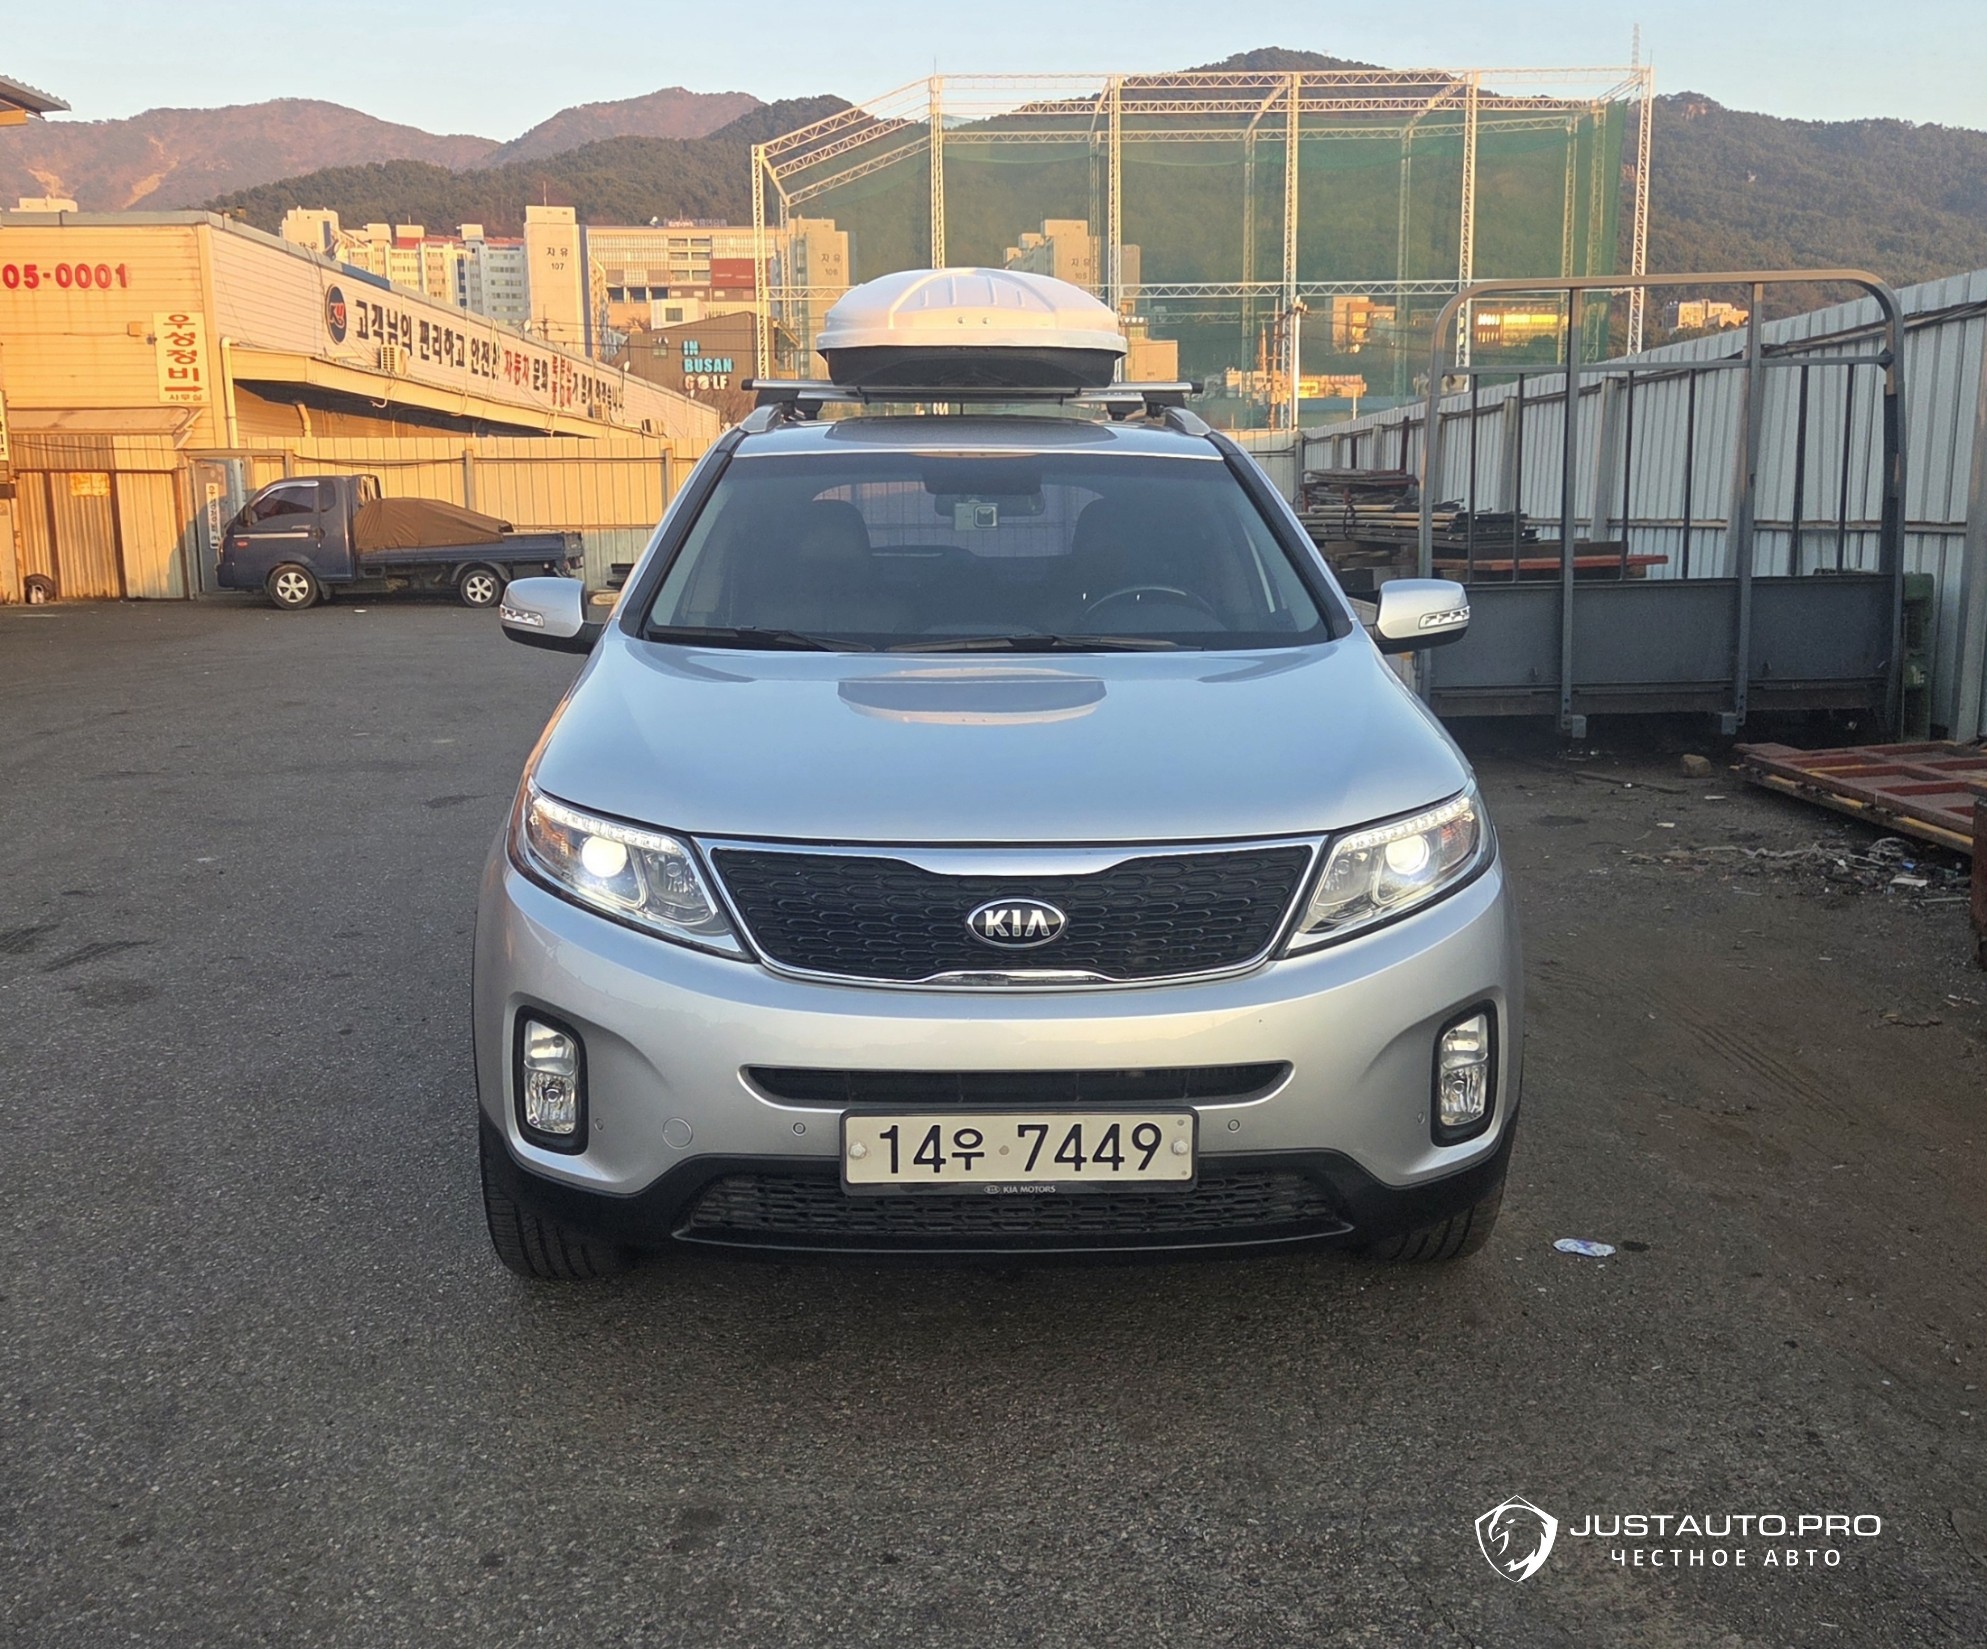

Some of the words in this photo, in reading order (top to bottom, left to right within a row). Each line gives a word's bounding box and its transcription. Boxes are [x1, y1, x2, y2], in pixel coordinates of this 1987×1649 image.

[2, 263, 127, 289] 05-0001
[551, 262, 565, 271] 107
[163, 314, 200, 382] 우성정비
[355, 299, 413, 356] 고객님의
[419, 320, 465, 368] 편리하고
[504, 350, 530, 386] 자동차
[683, 340, 699, 356] IN
[684, 357, 733, 373] BUSAN
[684, 374, 728, 390] GOLF
[984, 909, 1051, 937] KIA
[879, 1123, 986, 1174] 14우
[1017, 1122, 1163, 1173] 7449
[1003, 1186, 1018, 1194] KIA
[1020, 1185, 1056, 1194] MOTORS
